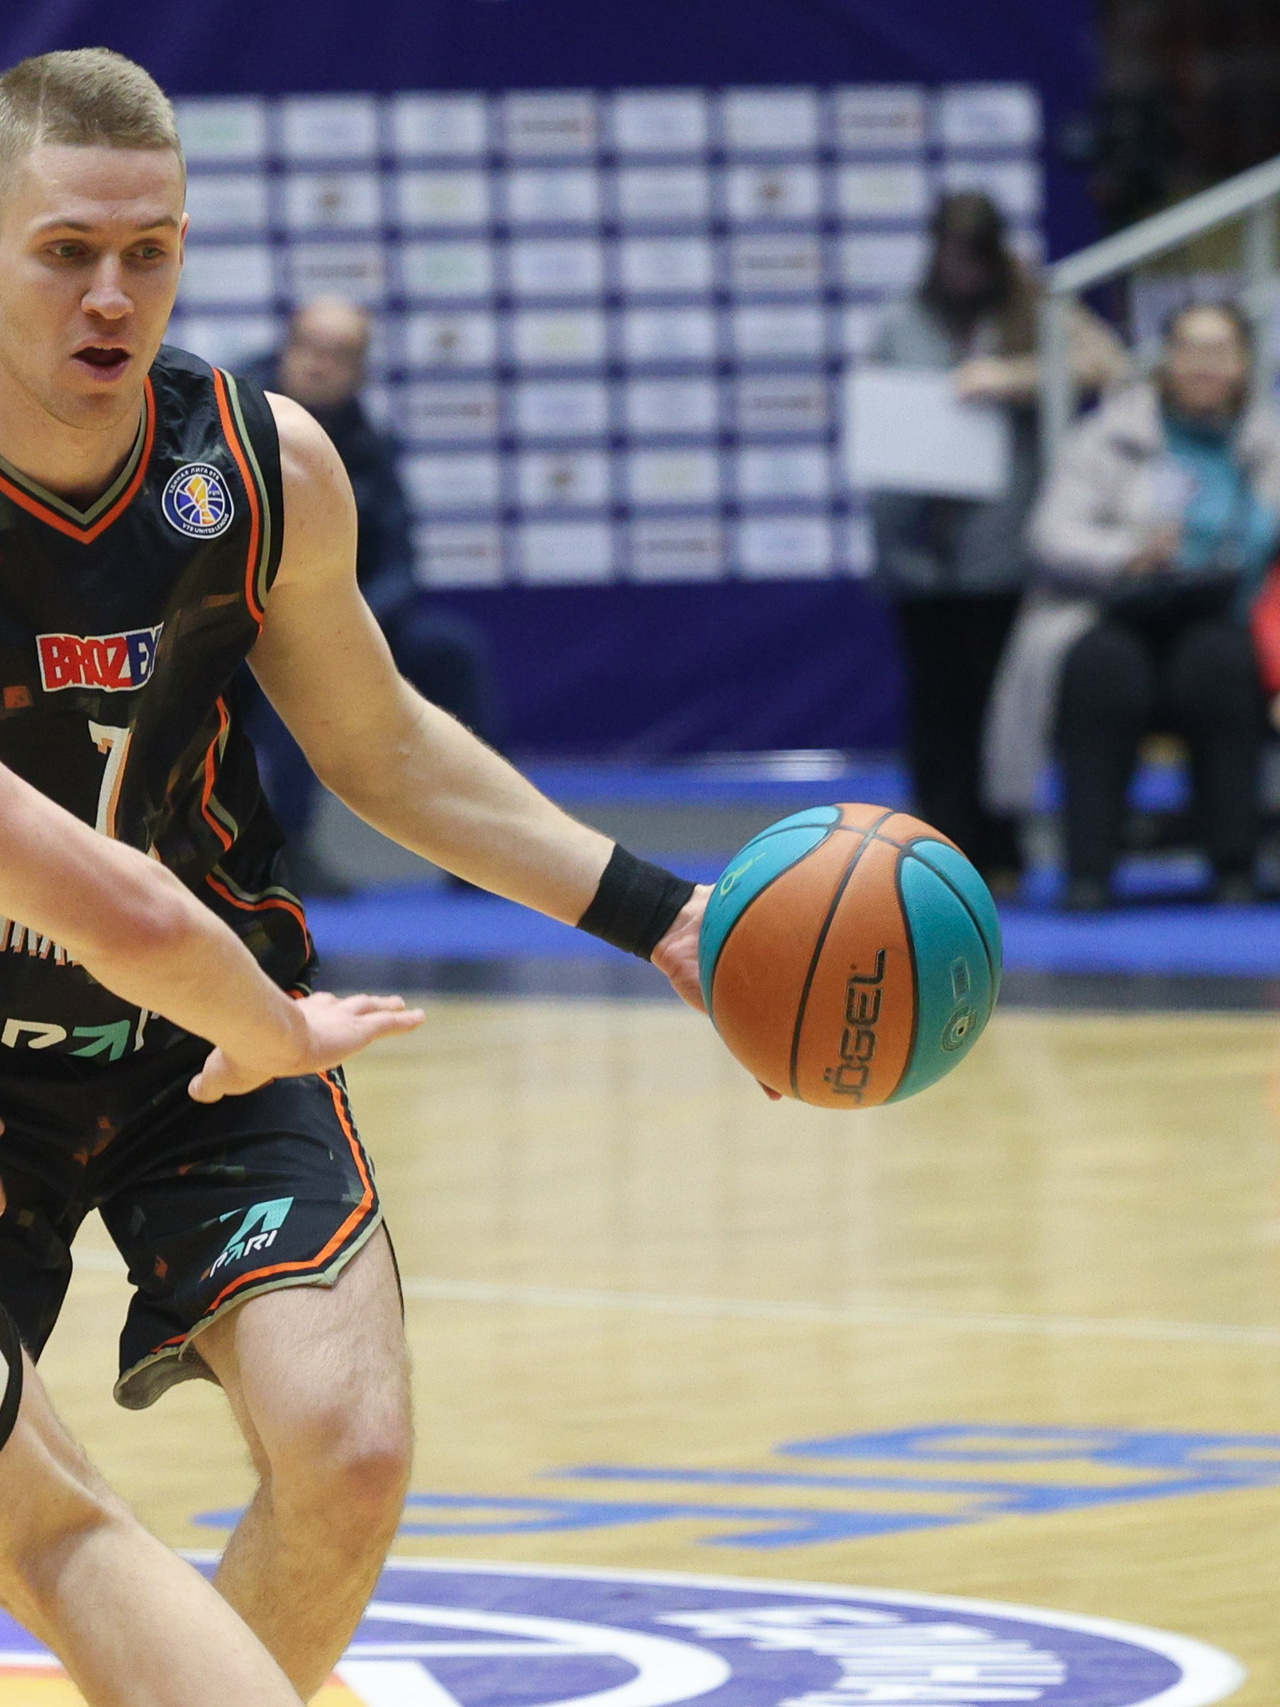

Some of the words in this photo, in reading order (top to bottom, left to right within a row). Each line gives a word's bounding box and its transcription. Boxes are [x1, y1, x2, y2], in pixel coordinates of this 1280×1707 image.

[88, 720, 132, 837] 7
[823, 949, 887, 1104] JÖGEL
[209, 1229, 278, 1279] PARI
